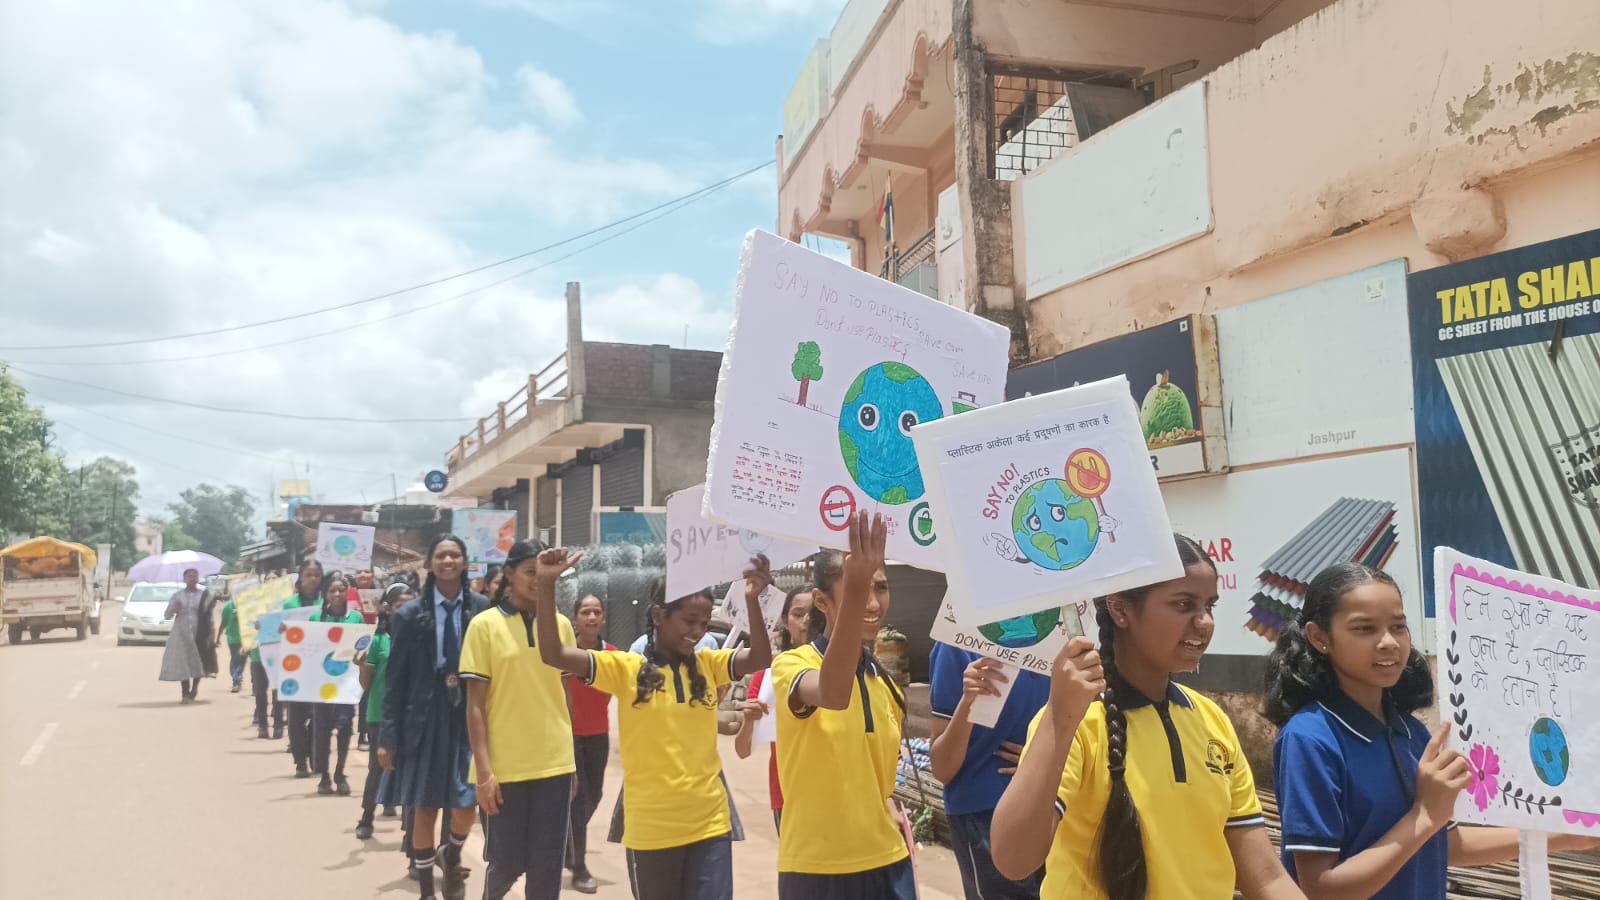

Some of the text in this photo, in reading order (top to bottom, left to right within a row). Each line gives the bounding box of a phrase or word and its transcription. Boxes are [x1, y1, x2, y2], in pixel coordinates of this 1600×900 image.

[774, 262, 808, 298] SAY
[820, 284, 838, 304] NO
[1436, 277, 1512, 325] TATA
[1438, 328, 1454, 341] GC
[1455, 320, 1488, 338] SHEET
[1490, 314, 1522, 332] FROM
[1524, 309, 1547, 325] THE
[1548, 301, 1590, 321] HOUSE
[947, 443, 983, 458] प्लास्टिक
[986, 436, 1013, 450] अकेला
[1016, 429, 1031, 443] कई
[1065, 422, 1076, 432] का
[1079, 417, 1100, 429] कारक
[1103, 412, 1110, 425] है
[1307, 430, 1356, 446] Jashpur
[982, 462, 1020, 520] SAY NO!
[1005, 466, 1050, 505] TO PLASTICS
[1199, 538, 1235, 562] AR
[955, 632, 1054, 671] DON'T USE PLAS
